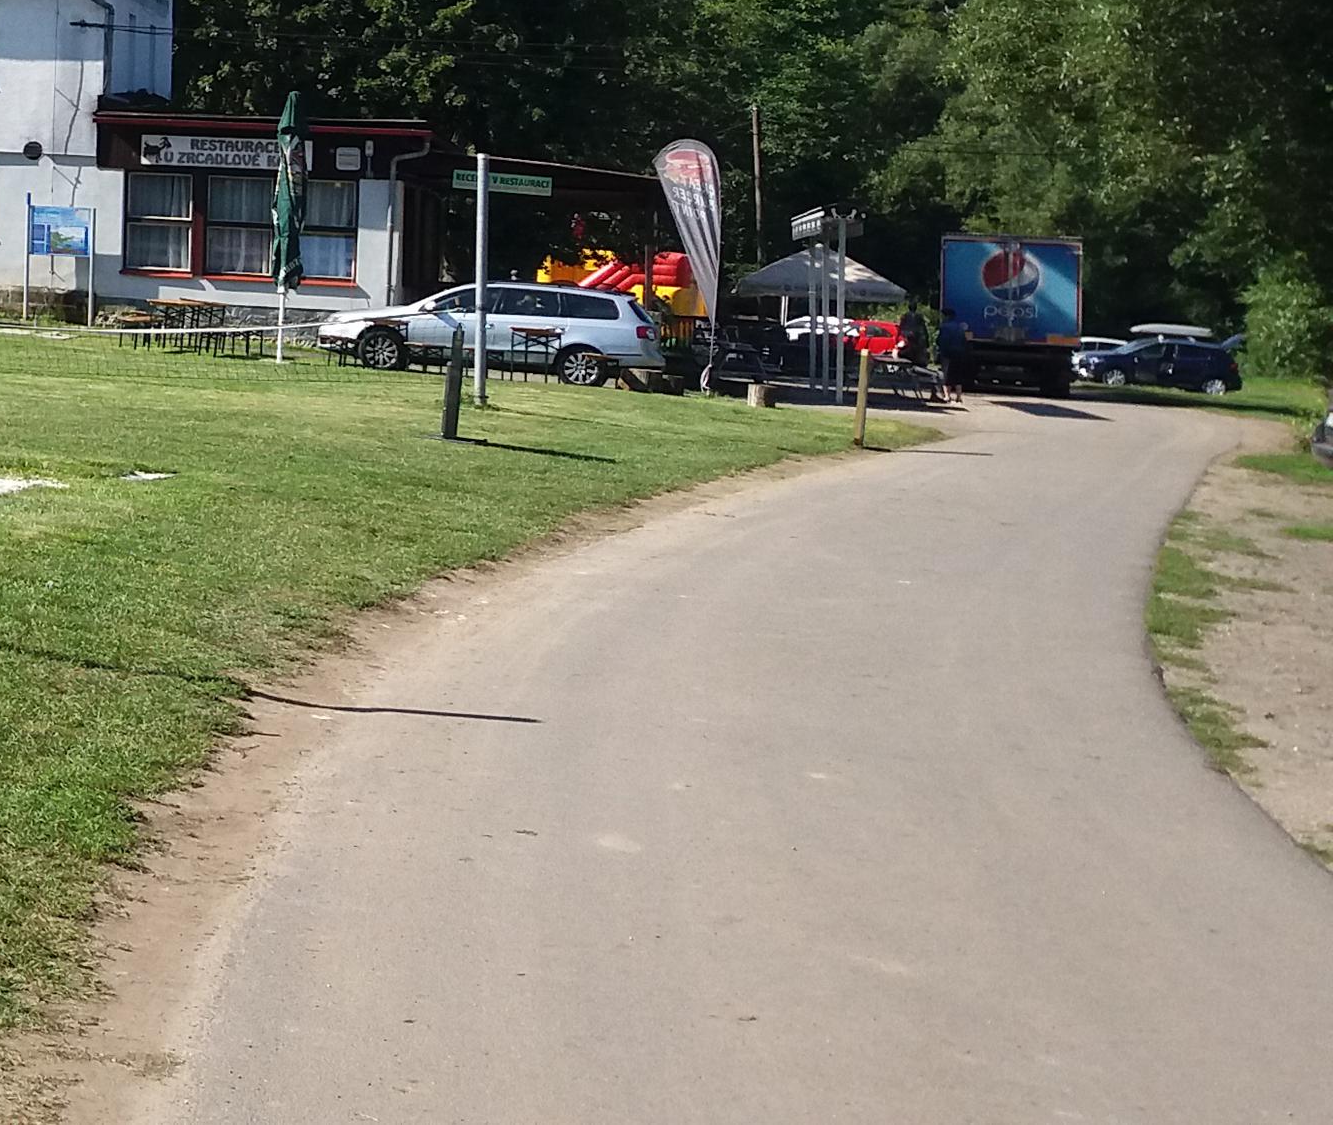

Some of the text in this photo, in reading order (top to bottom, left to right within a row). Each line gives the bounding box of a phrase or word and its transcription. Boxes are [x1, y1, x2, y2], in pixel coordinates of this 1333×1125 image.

[191, 139, 280, 154] RESTAURACE
[163, 151, 174, 163] U
[983, 304, 1038, 327] pepsi
